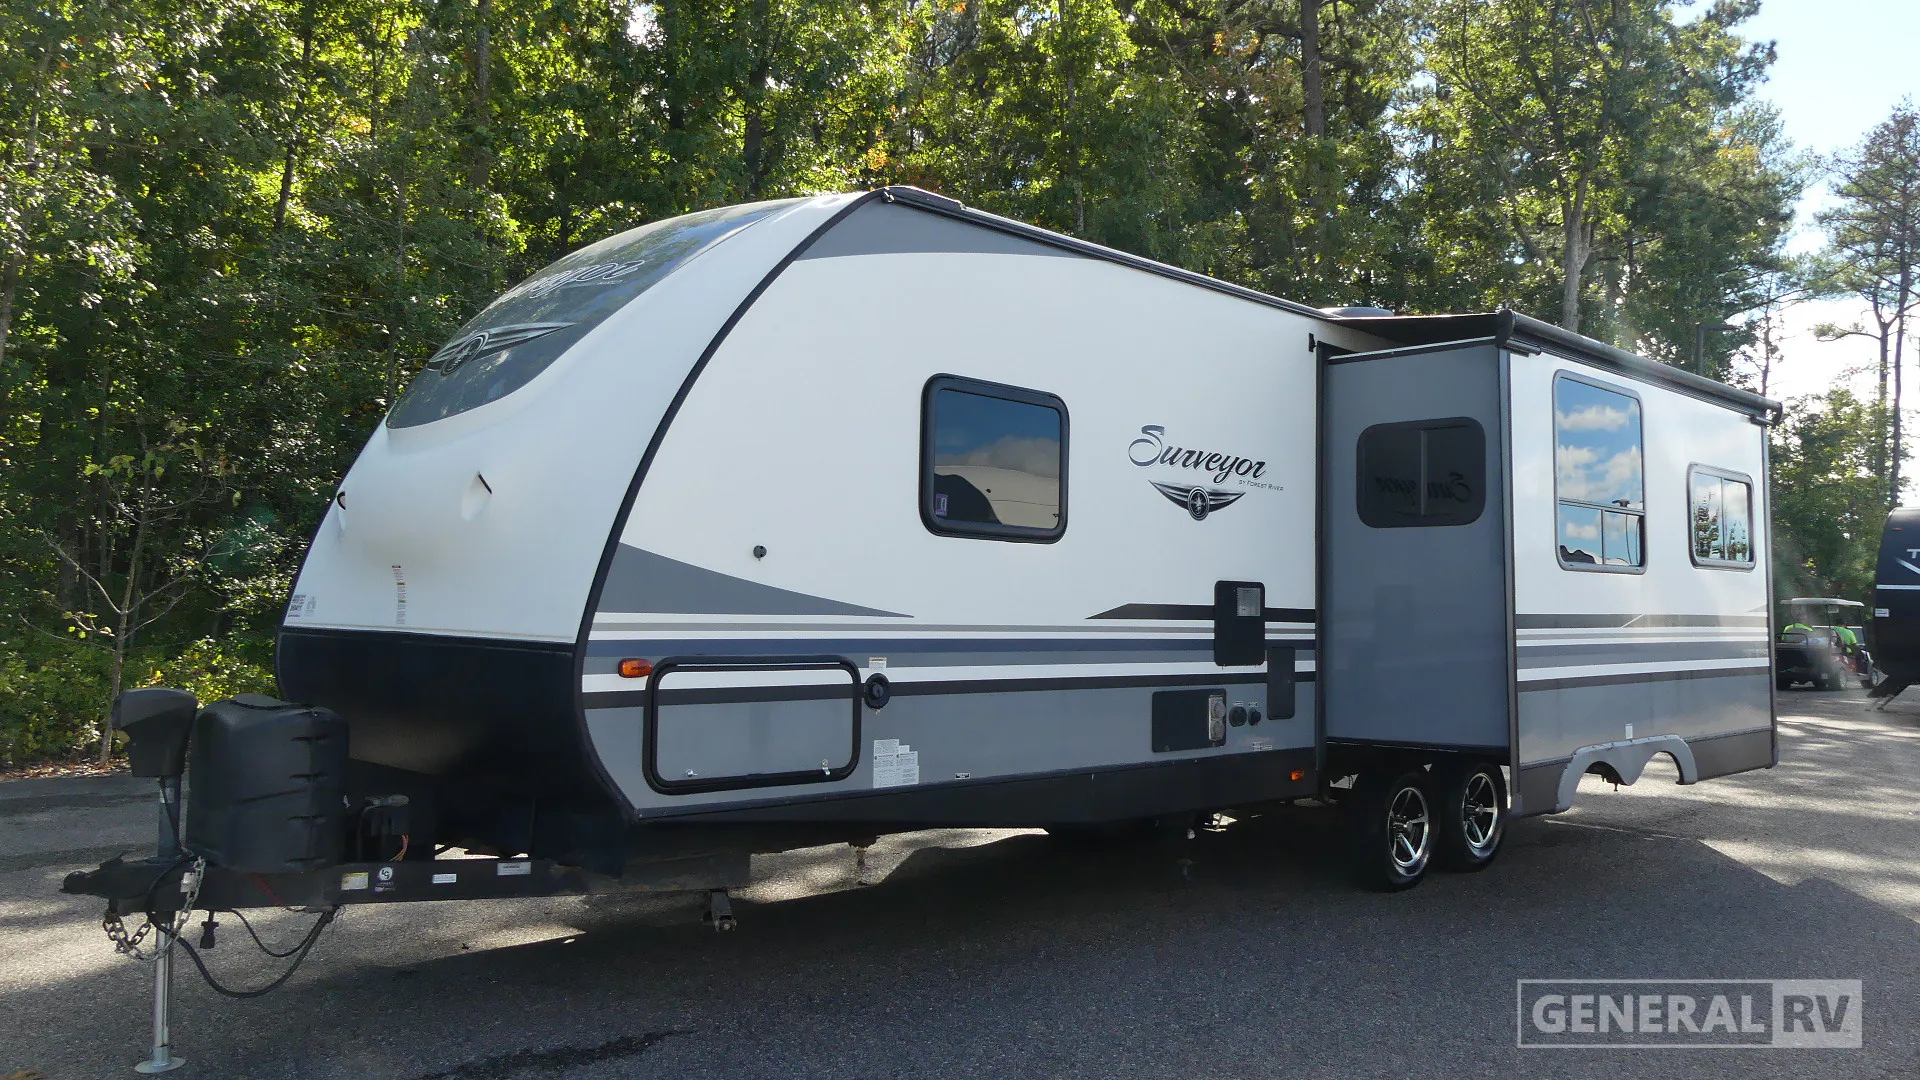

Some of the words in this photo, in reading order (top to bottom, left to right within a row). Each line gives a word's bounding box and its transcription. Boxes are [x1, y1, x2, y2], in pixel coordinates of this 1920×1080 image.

[1128, 424, 1267, 484] Surveyor
[1246, 480, 1267, 489] FOREST
[1267, 483, 1284, 491] RIVER
